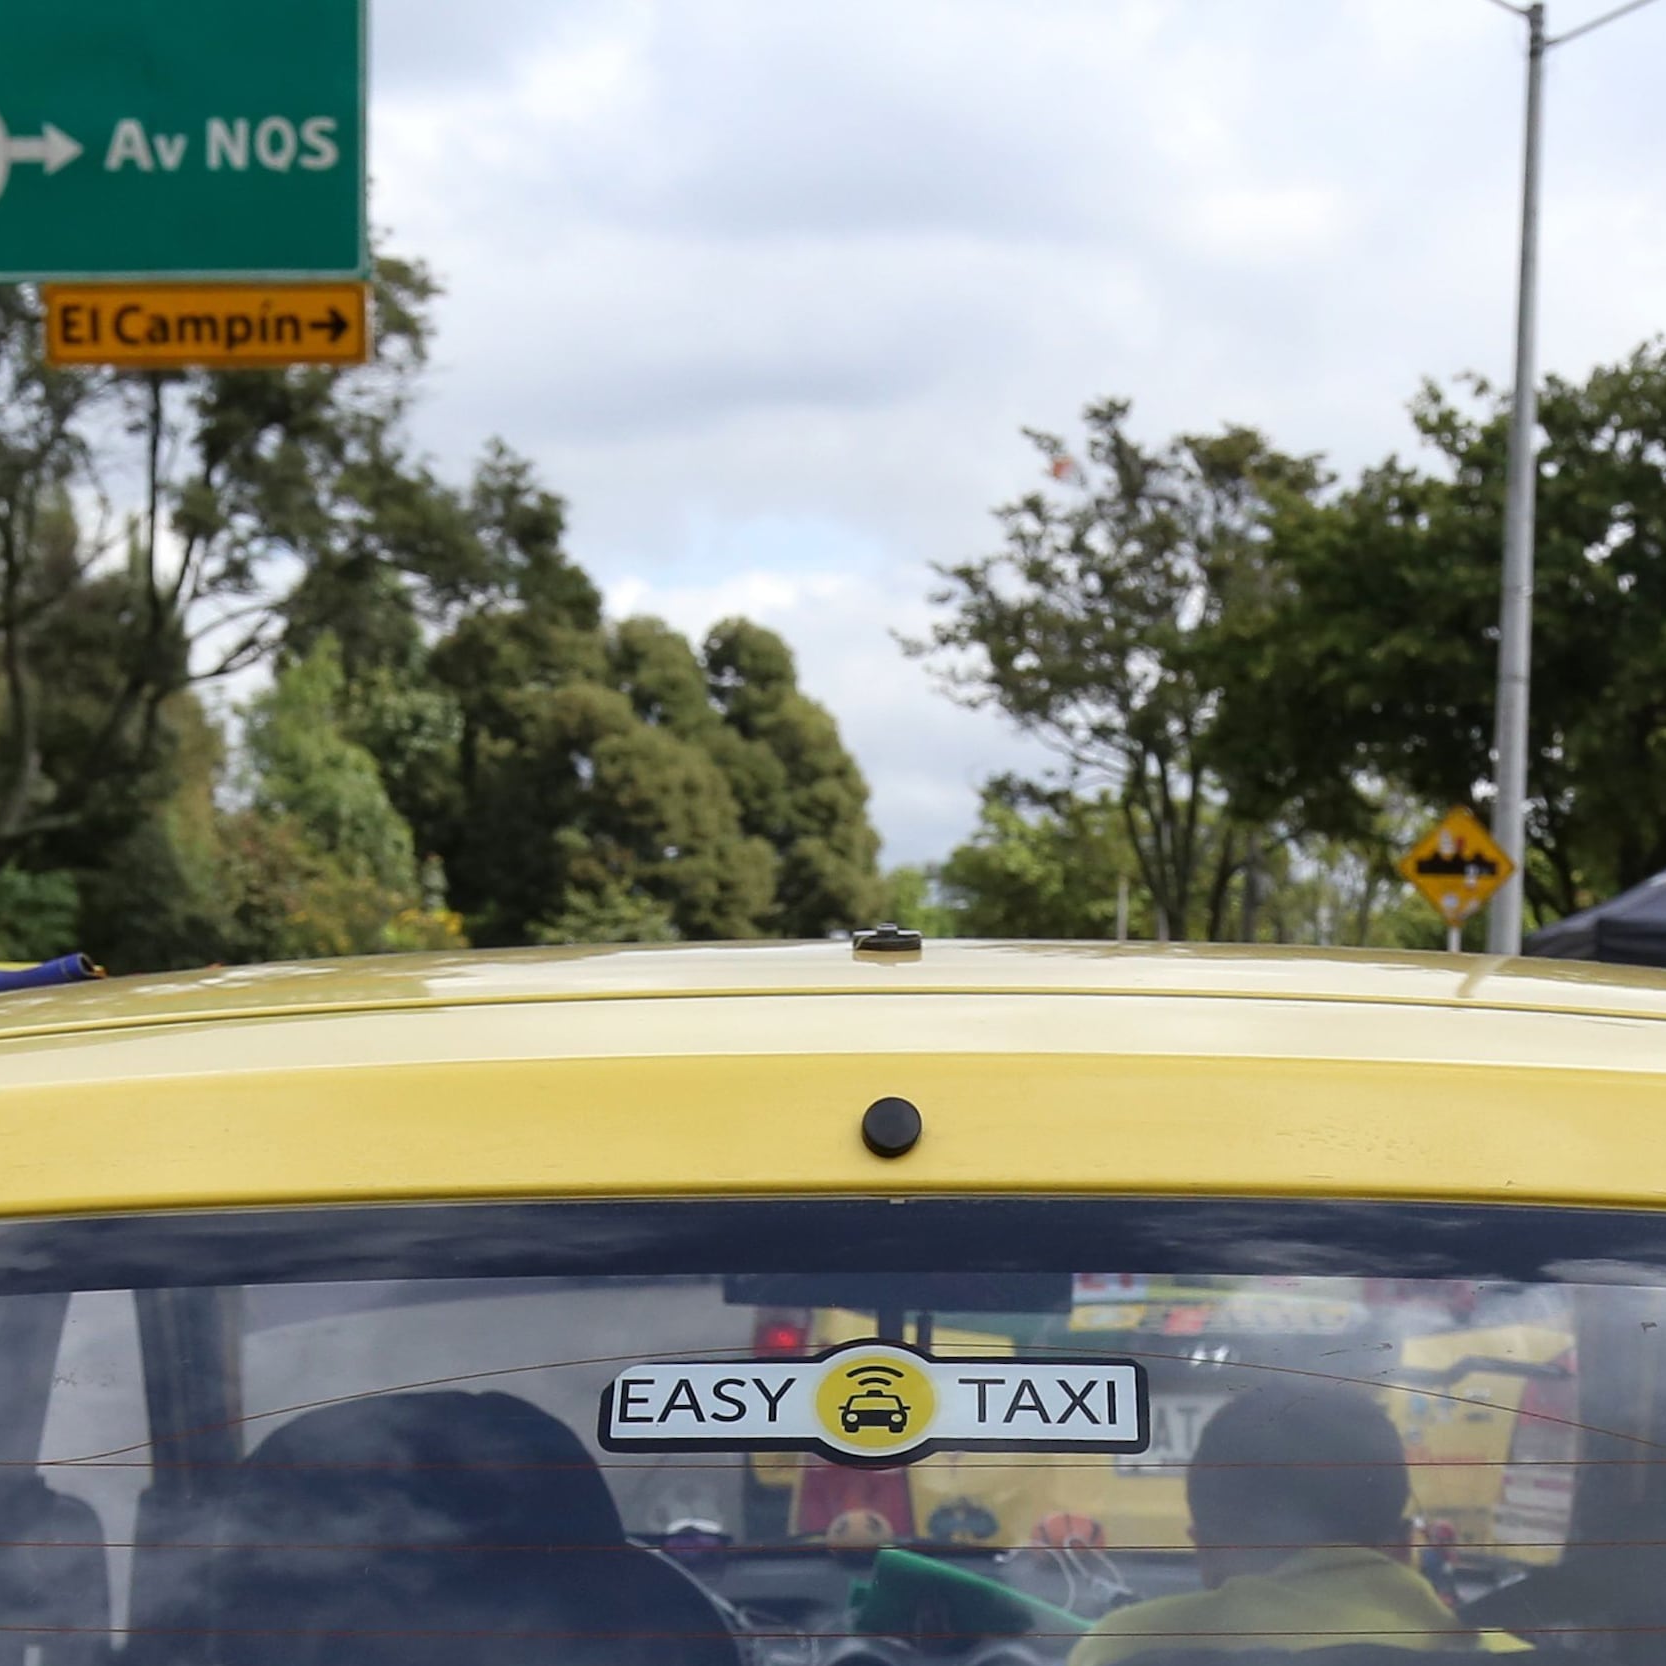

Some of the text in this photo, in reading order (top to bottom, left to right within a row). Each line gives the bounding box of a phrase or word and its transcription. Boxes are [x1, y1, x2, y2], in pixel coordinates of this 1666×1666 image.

[105, 116, 340, 174] Av NQS
[61, 299, 302, 354] El Campín
[617, 1374, 1118, 1426] EASY TAXI
